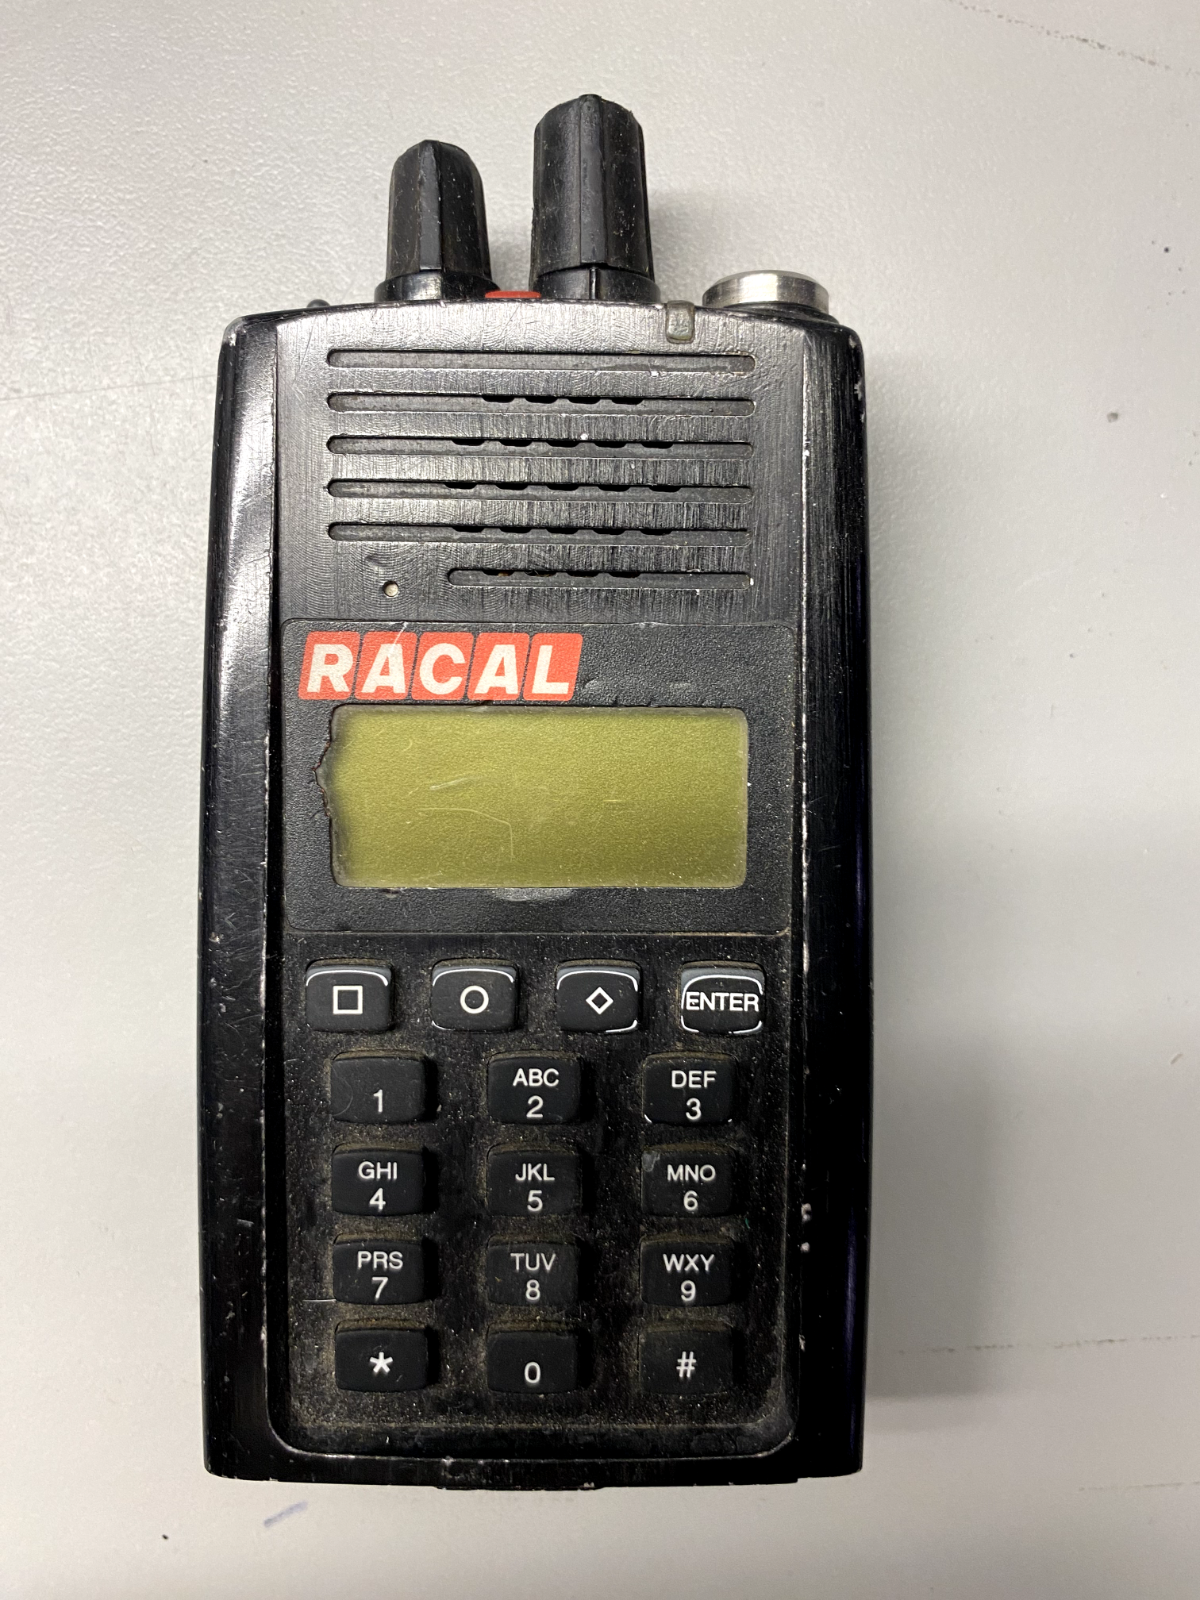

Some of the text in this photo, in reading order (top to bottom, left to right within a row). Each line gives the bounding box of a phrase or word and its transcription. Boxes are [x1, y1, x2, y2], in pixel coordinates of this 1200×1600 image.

[306, 642, 572, 695] RACAL
[685, 991, 760, 1013] ENTER
[512, 1067, 560, 1088] ABC
[671, 1070, 718, 1090] DEF
[372, 1088, 384, 1114] 1
[526, 1095, 545, 1119] 2
[685, 1097, 703, 1122] 3
[358, 1161, 399, 1181] GHI
[515, 1163, 556, 1183] JKL
[667, 1164, 717, 1183] MNO
[369, 1187, 387, 1212] 4
[527, 1189, 544, 1213] 5
[683, 1190, 699, 1212] 6
[357, 1250, 405, 1271] PRS
[510, 1252, 557, 1273] TUV
[662, 1253, 716, 1273] WXY
[371, 1276, 390, 1300] 7
[525, 1279, 542, 1302] 8
[680, 1280, 697, 1303] 9
